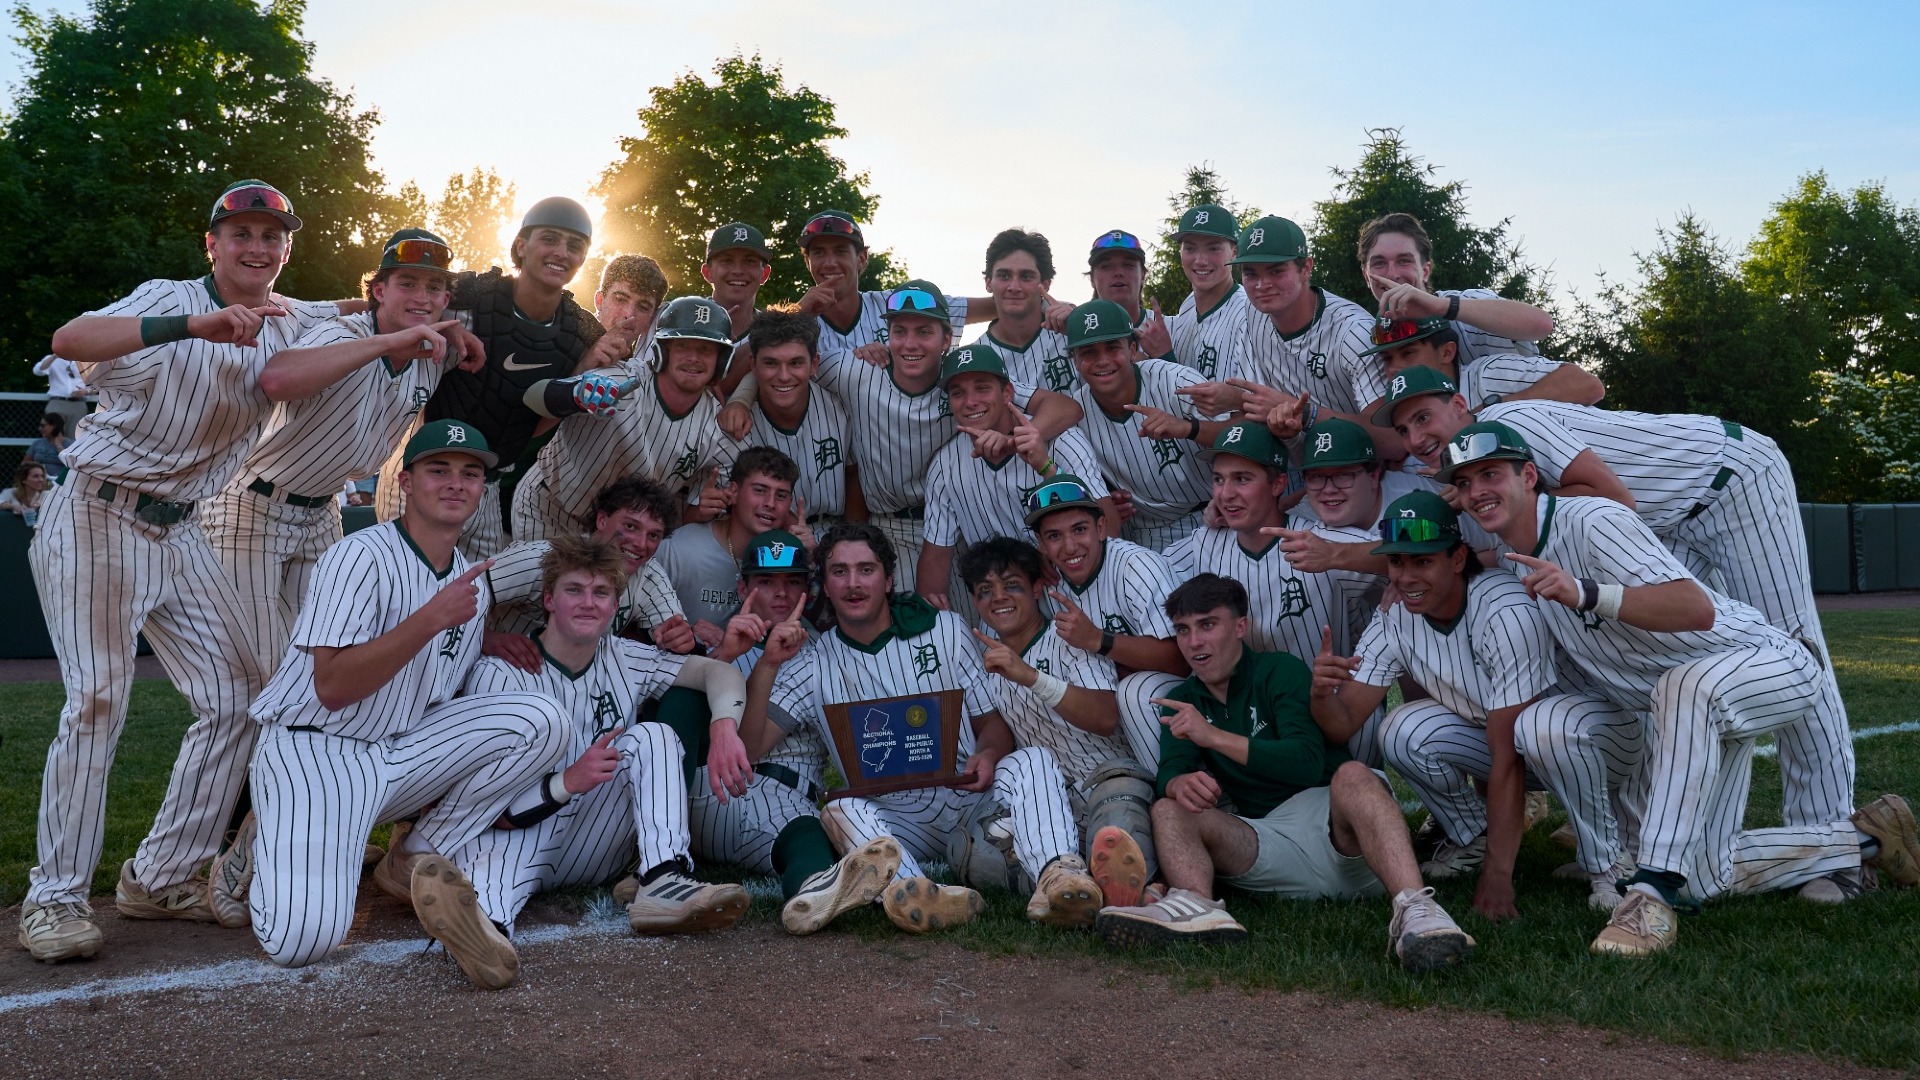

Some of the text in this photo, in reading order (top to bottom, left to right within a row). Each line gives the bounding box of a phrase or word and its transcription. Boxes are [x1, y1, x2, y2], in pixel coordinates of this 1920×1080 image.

[1193, 210, 1210, 228] D
[733, 227, 749, 243] D
[1247, 228, 1265, 251] D
[693, 303, 712, 325] D
[1084, 312, 1100, 335] D
[957, 349, 974, 369] D
[1391, 375, 1408, 400] D
[446, 424, 467, 446] D
[1222, 425, 1244, 447] D
[1313, 432, 1334, 458] D
[812, 437, 843, 483] D
[1276, 575, 1312, 628] D
[912, 642, 942, 682] D
[862, 730, 895, 739] SECTIONAL
[862, 740, 897, 749] CHAMPIONS
[904, 739, 934, 749] NON-PUBLIC
[905, 733, 931, 742] BASEBALL
